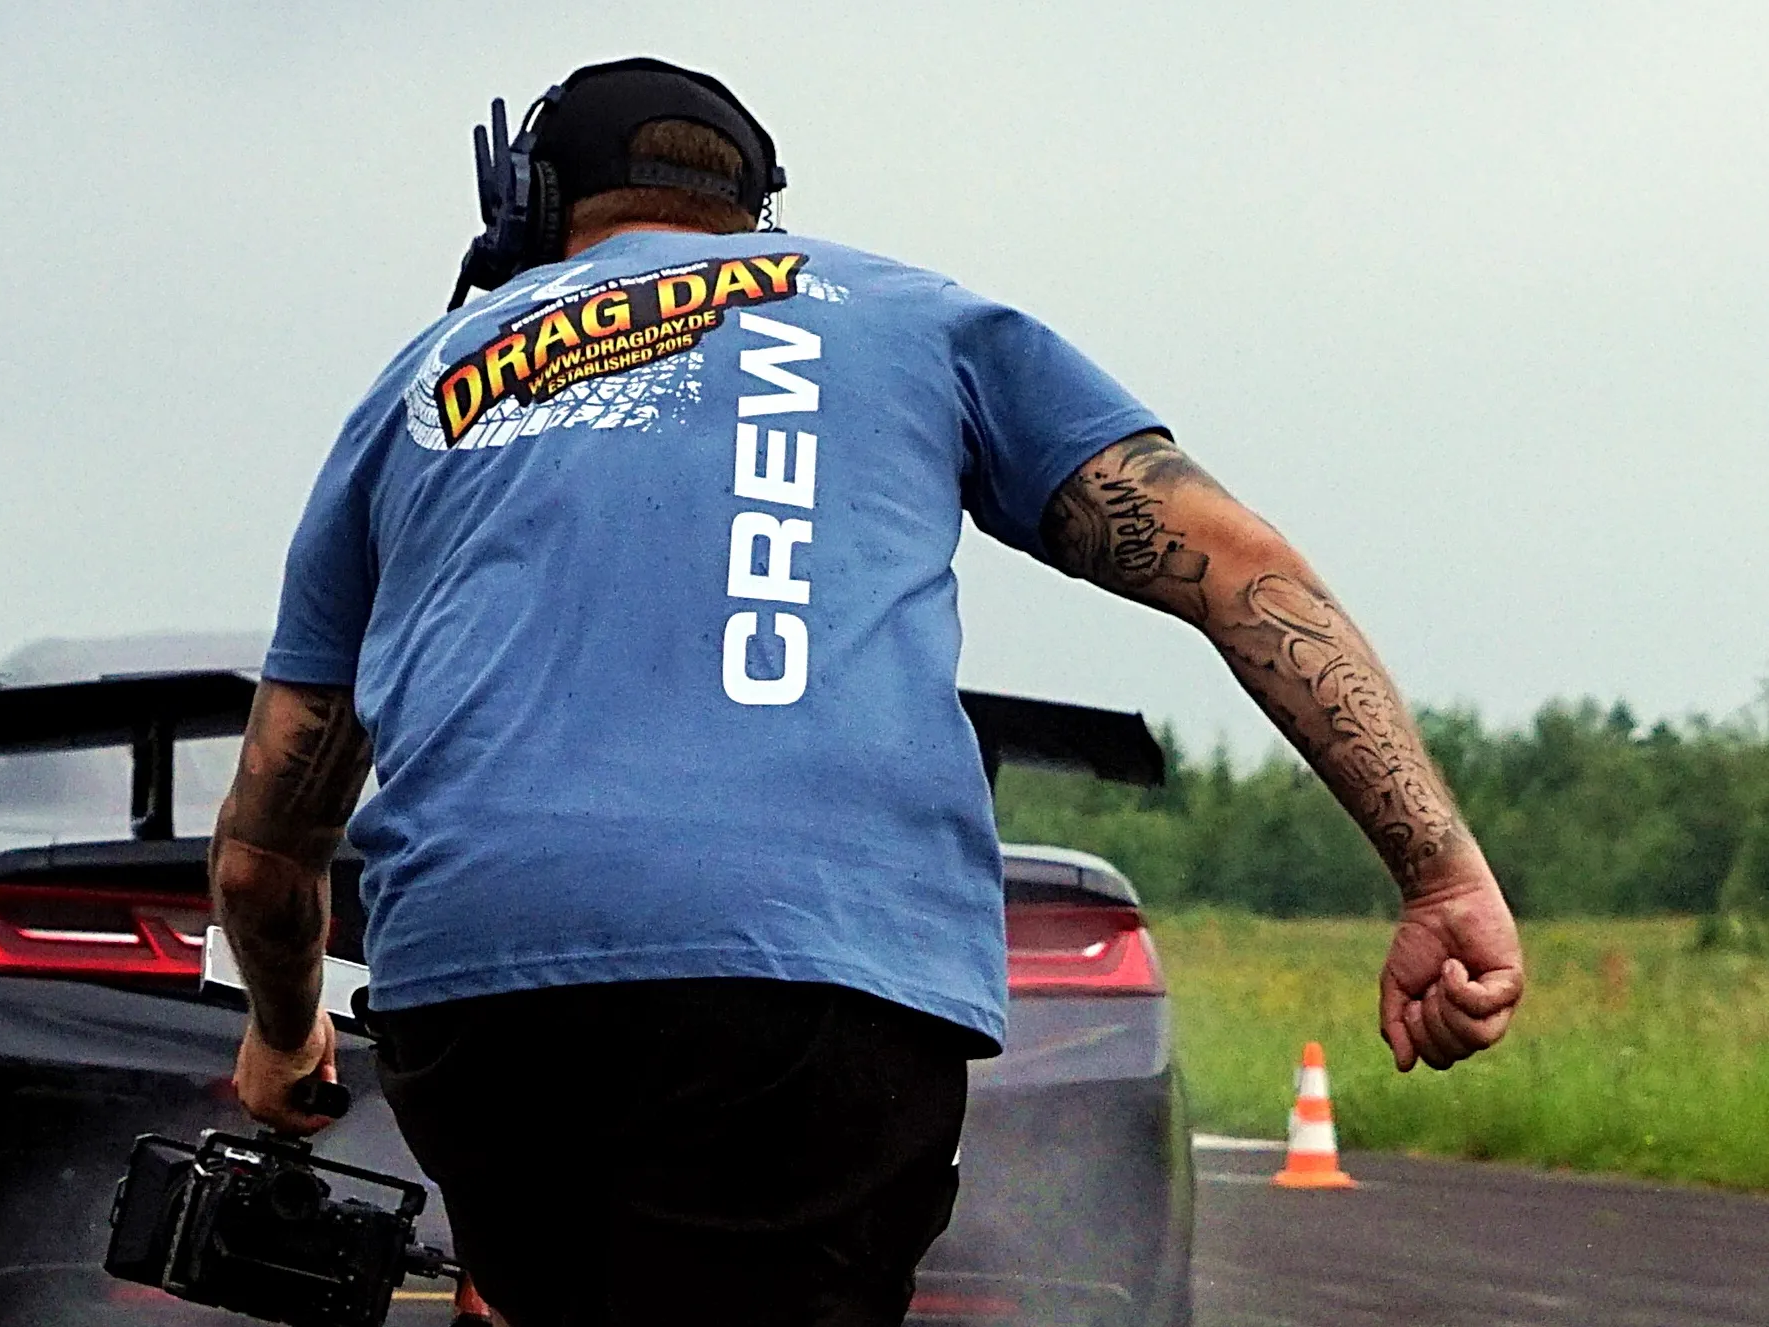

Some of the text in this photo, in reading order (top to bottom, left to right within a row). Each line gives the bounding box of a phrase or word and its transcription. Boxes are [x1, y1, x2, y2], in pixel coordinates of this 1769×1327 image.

[441, 253, 805, 440] DRAG DAY
[511, 299, 564, 332] presented
[566, 293, 579, 304] by
[608, 280, 618, 291] &
[528, 310, 717, 395] WWW.DRAGDAY.DE
[548, 333, 693, 394] ESTABLISHED 2015
[722, 311, 822, 706] CREW
